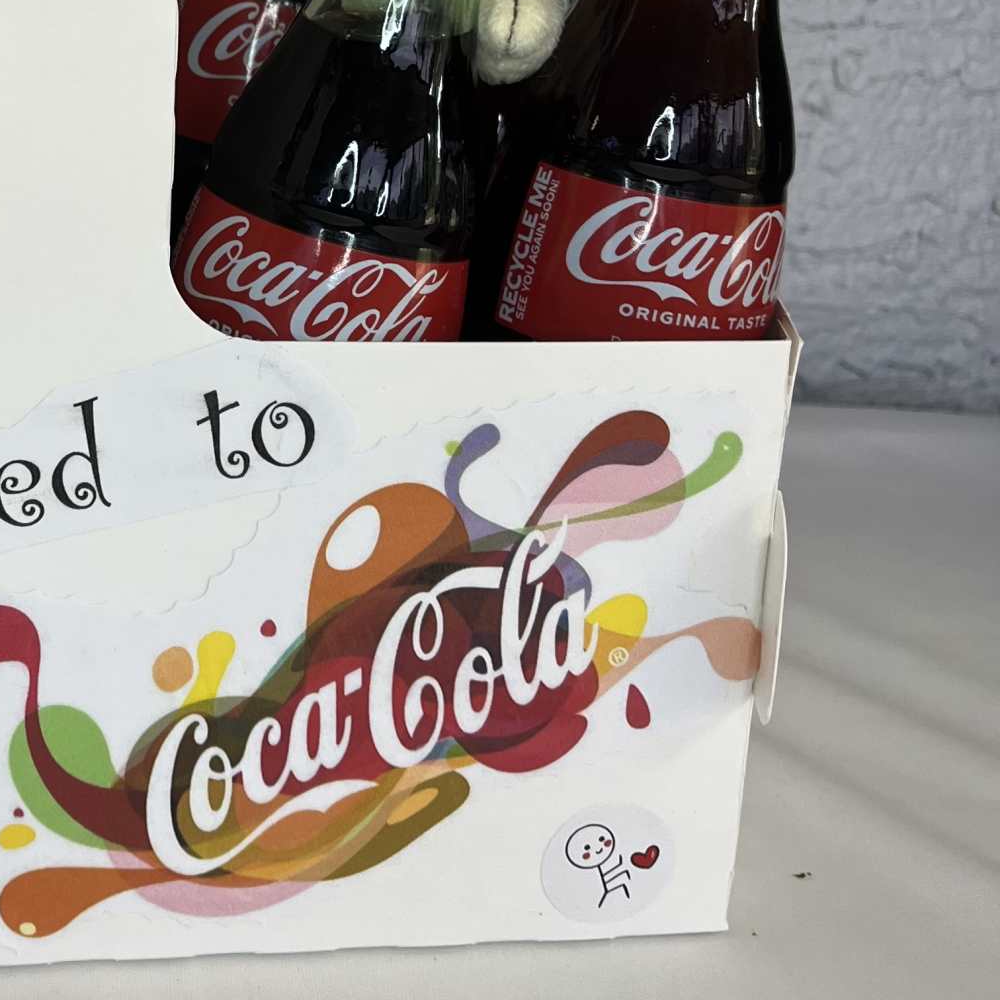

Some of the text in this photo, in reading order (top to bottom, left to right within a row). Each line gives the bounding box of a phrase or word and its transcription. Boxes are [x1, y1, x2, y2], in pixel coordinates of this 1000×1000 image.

[499, 166, 553, 322] RECYCLE ME
[516, 296, 528, 320] SEE
[522, 265, 536, 291] YOU
[530, 224, 546, 265] AGAIN
[565, 196, 785, 307] Coca-Col
[618, 303, 767, 331] ORIGINAL TASTE
[196, 389, 317, 479] to
[145, 515, 599, 877] Coca-Cola
